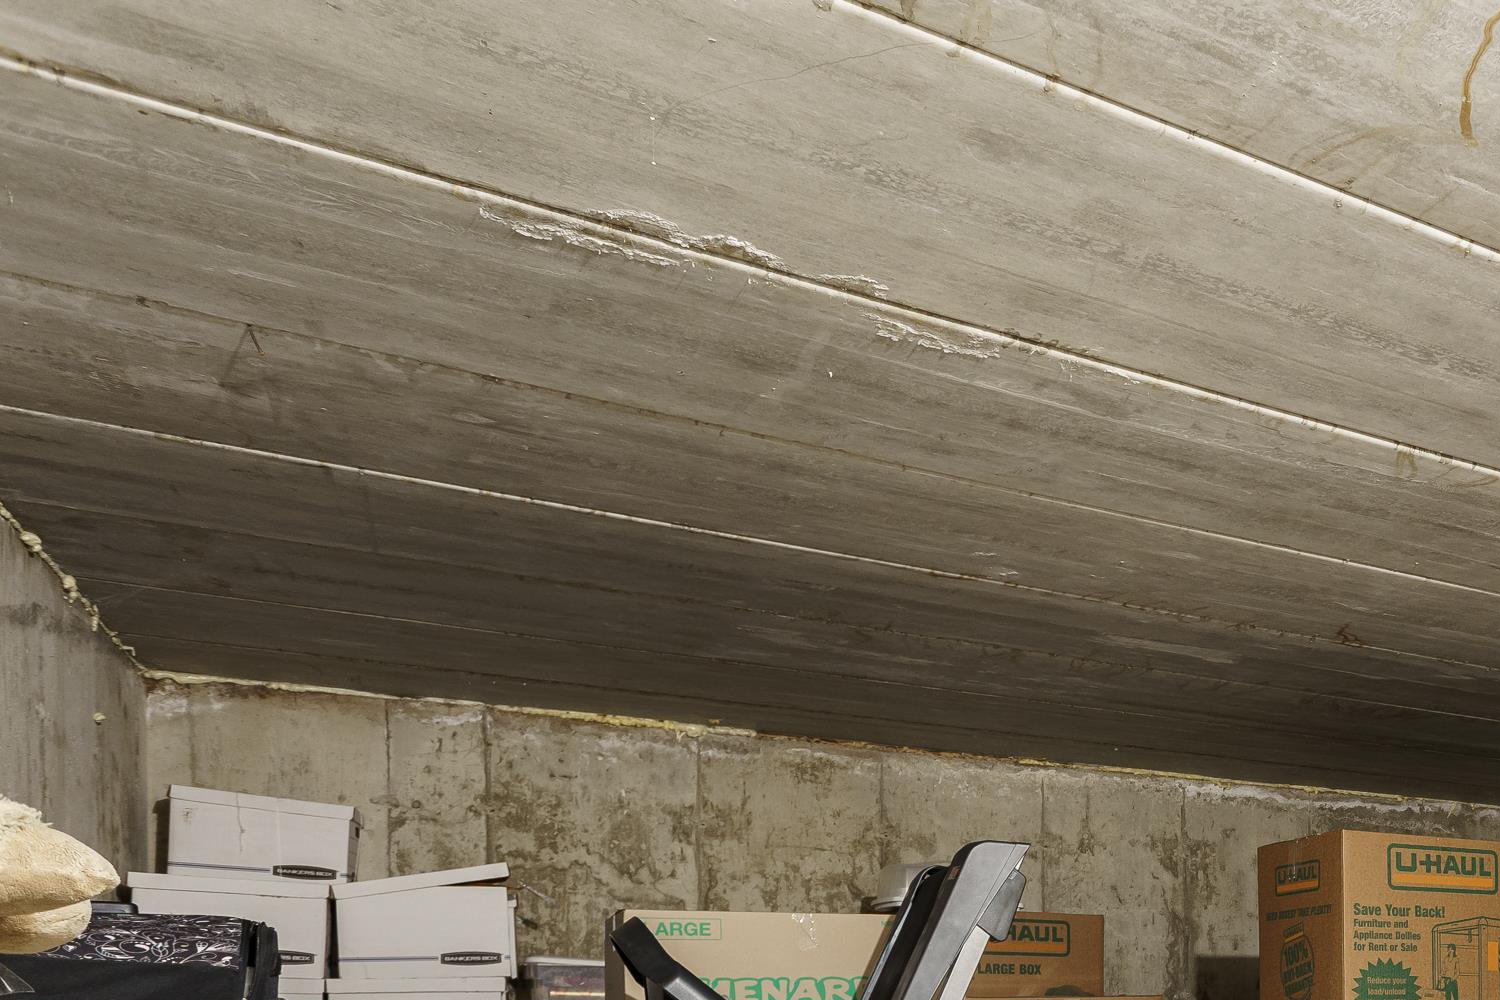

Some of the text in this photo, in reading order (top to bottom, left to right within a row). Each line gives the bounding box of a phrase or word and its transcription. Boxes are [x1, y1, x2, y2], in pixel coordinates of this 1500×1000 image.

[1395, 851, 1492, 877] U-HAUL
[277, 868, 316, 876] BANKERS
[1353, 902, 1445, 919] Save Your Back!
[655, 921, 712, 937] ARGE
[1353, 918, 1409, 929] Furniture and
[1353, 930, 1421, 941] Appliance Dollies
[1353, 942, 1418, 952] for Rent or Sale
[1019, 963, 1042, 976] BOX
[1367, 976, 1407, 986] Reduce your
[1367, 988, 1406, 996] load/unload
